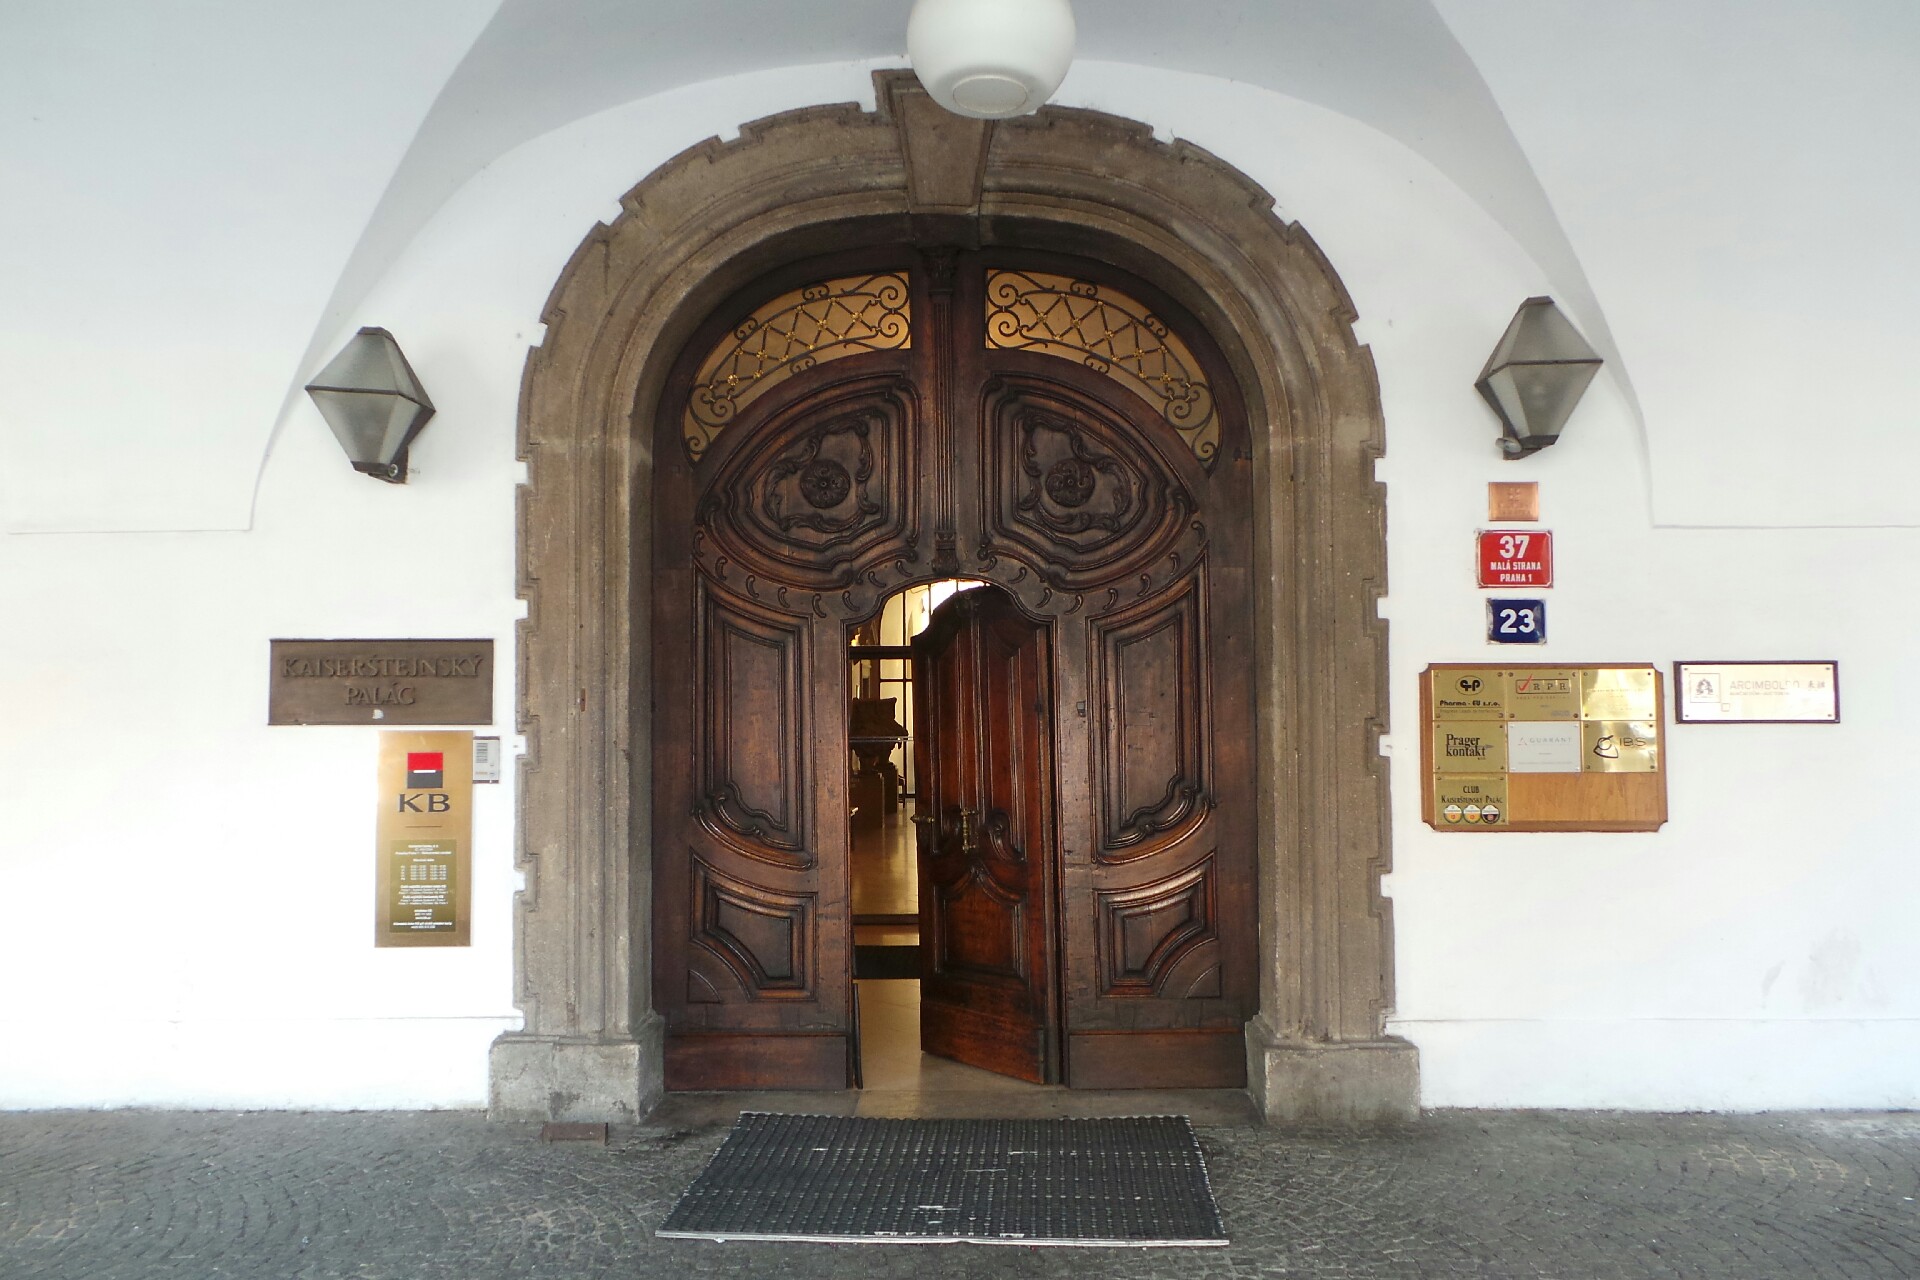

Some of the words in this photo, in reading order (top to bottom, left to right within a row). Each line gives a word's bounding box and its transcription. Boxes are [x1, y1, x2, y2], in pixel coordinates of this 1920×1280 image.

[1499, 535, 1530, 559] 37
[1490, 560, 1511, 571] MALÁ
[1512, 562, 1541, 571] STRANA
[1500, 574, 1527, 582] PRAHA
[1528, 573, 1532, 582] 1
[1499, 608, 1536, 634] 23
[1445, 733, 1481, 749] Prager
[1619, 737, 1647, 747] IBS
[1445, 744, 1486, 757] kontakt
[1462, 785, 1480, 794] CLUB
[398, 793, 451, 813] KB
